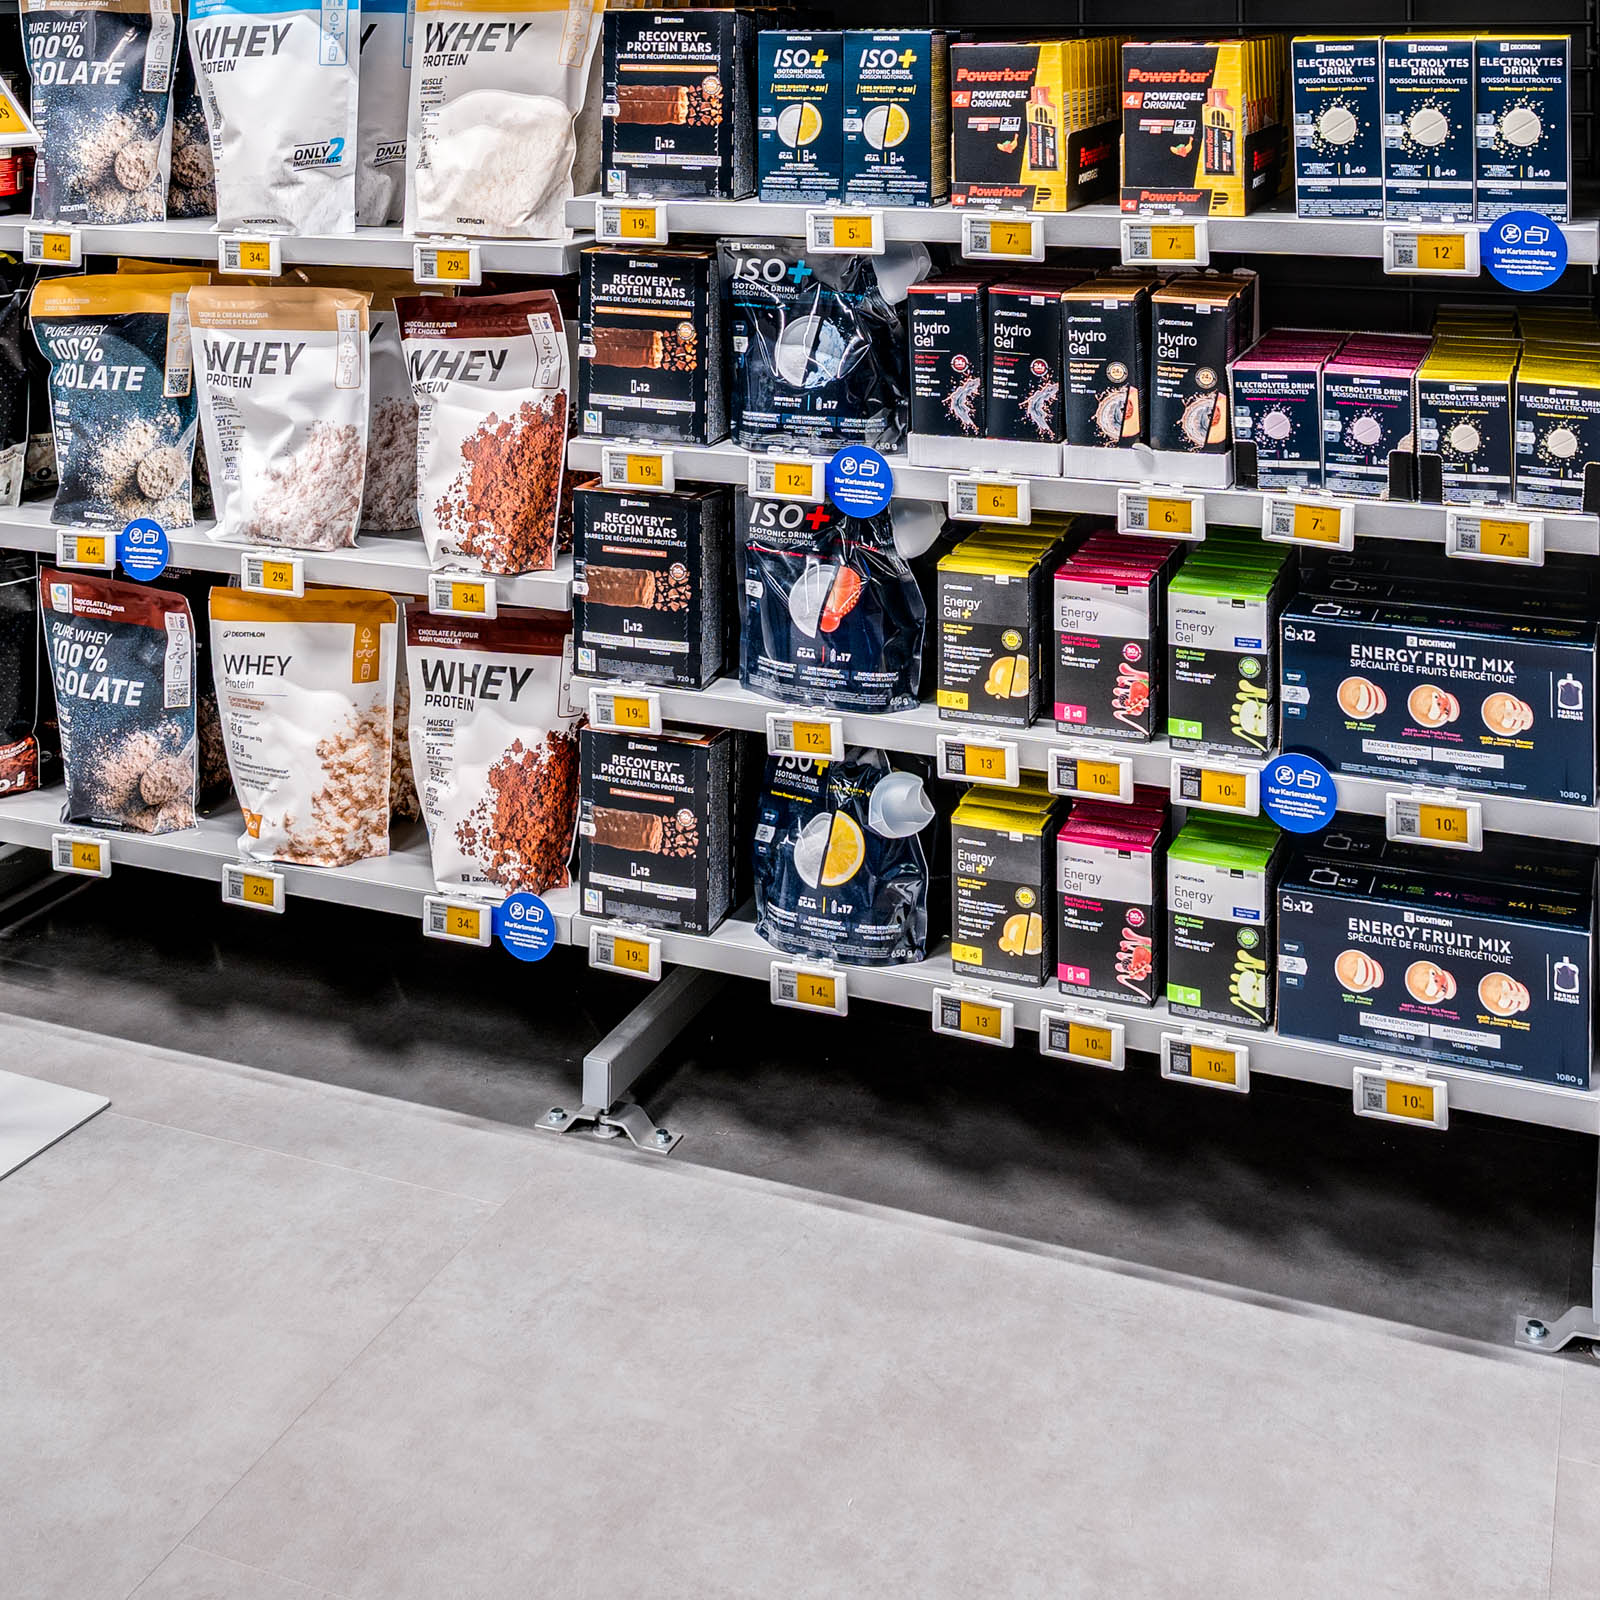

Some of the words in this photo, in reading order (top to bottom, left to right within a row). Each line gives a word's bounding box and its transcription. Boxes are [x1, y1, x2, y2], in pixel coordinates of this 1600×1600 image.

[194, 22, 292, 60] WHEY
[424, 21, 534, 55] WHEY
[626, 41, 675, 54] PROTEIN
[678, 41, 712, 52] BARS
[422, 52, 471, 69] PROTEIN
[1297, 56, 1376, 70] ELECTROLYTES
[956, 67, 1033, 84] Powerbar
[1318, 65, 1354, 77] DRINK
[970, 98, 1012, 110] ORIGINAL
[293, 148, 328, 162] ONLY
[914, 321, 950, 338] Hydro
[914, 334, 934, 348] Gel
[49, 338, 105, 365] 100%
[204, 340, 307, 378] WHEY
[206, 373, 253, 390] PROTEIN
[1061, 606, 1099, 621] Energy
[1061, 618, 1079, 629] Gel
[222, 654, 291, 678] WHEY
[1350, 643, 1419, 667] ENERGY
[1421, 649, 1476, 670] FRUIT
[1481, 656, 1515, 675] MIX
[421, 659, 534, 702] WHEY
[424, 694, 474, 712] PROTEIN
[427, 719, 454, 727] MUSCLE
